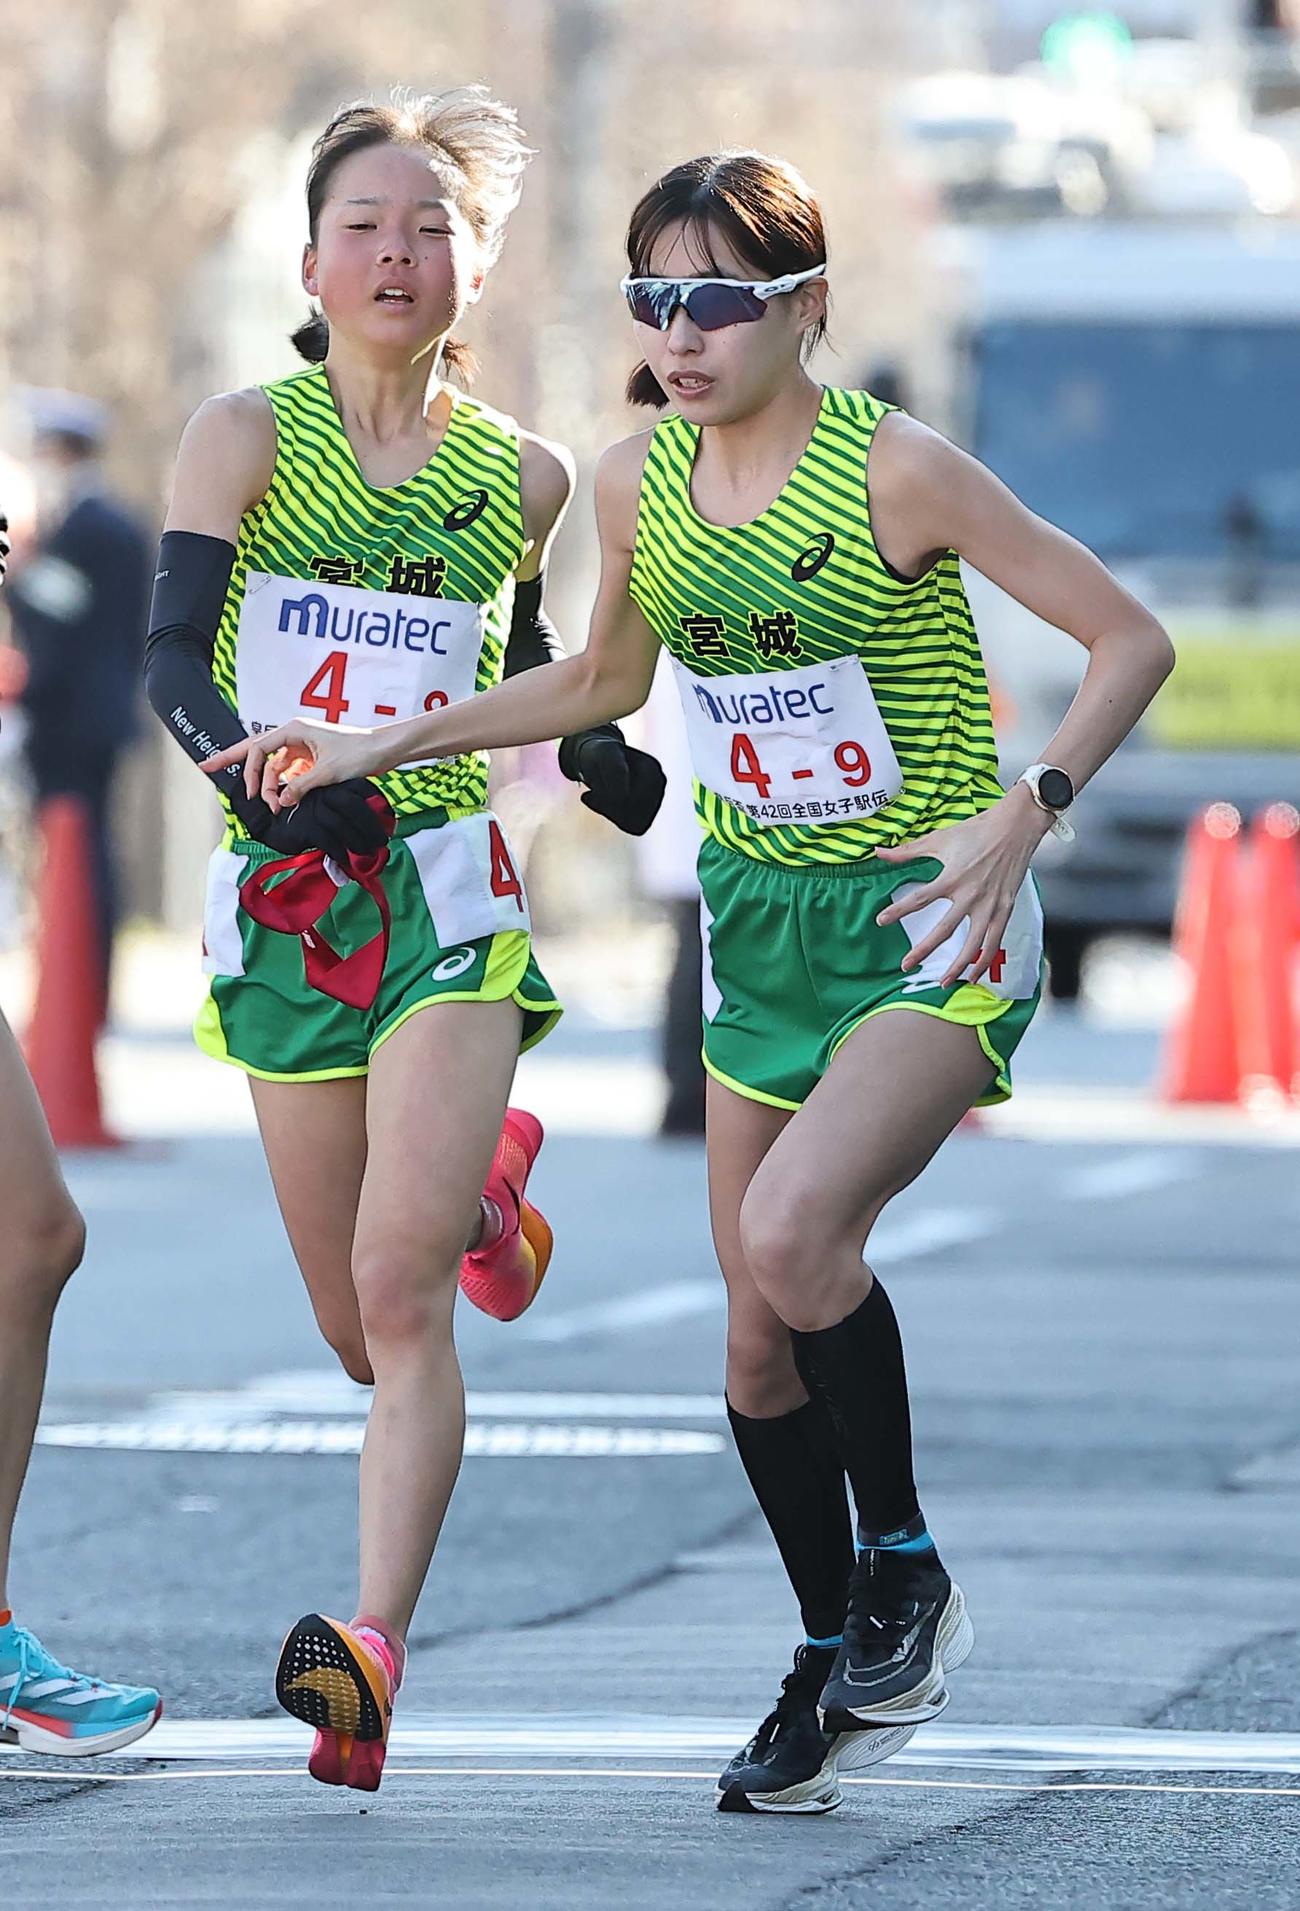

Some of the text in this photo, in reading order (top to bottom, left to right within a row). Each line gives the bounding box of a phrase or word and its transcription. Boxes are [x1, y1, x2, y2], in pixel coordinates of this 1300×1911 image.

[278, 593, 451, 655] muratec
[680, 611, 802, 659] 宮城
[170, 706, 197, 736] New
[489, 820, 525, 912] 4
